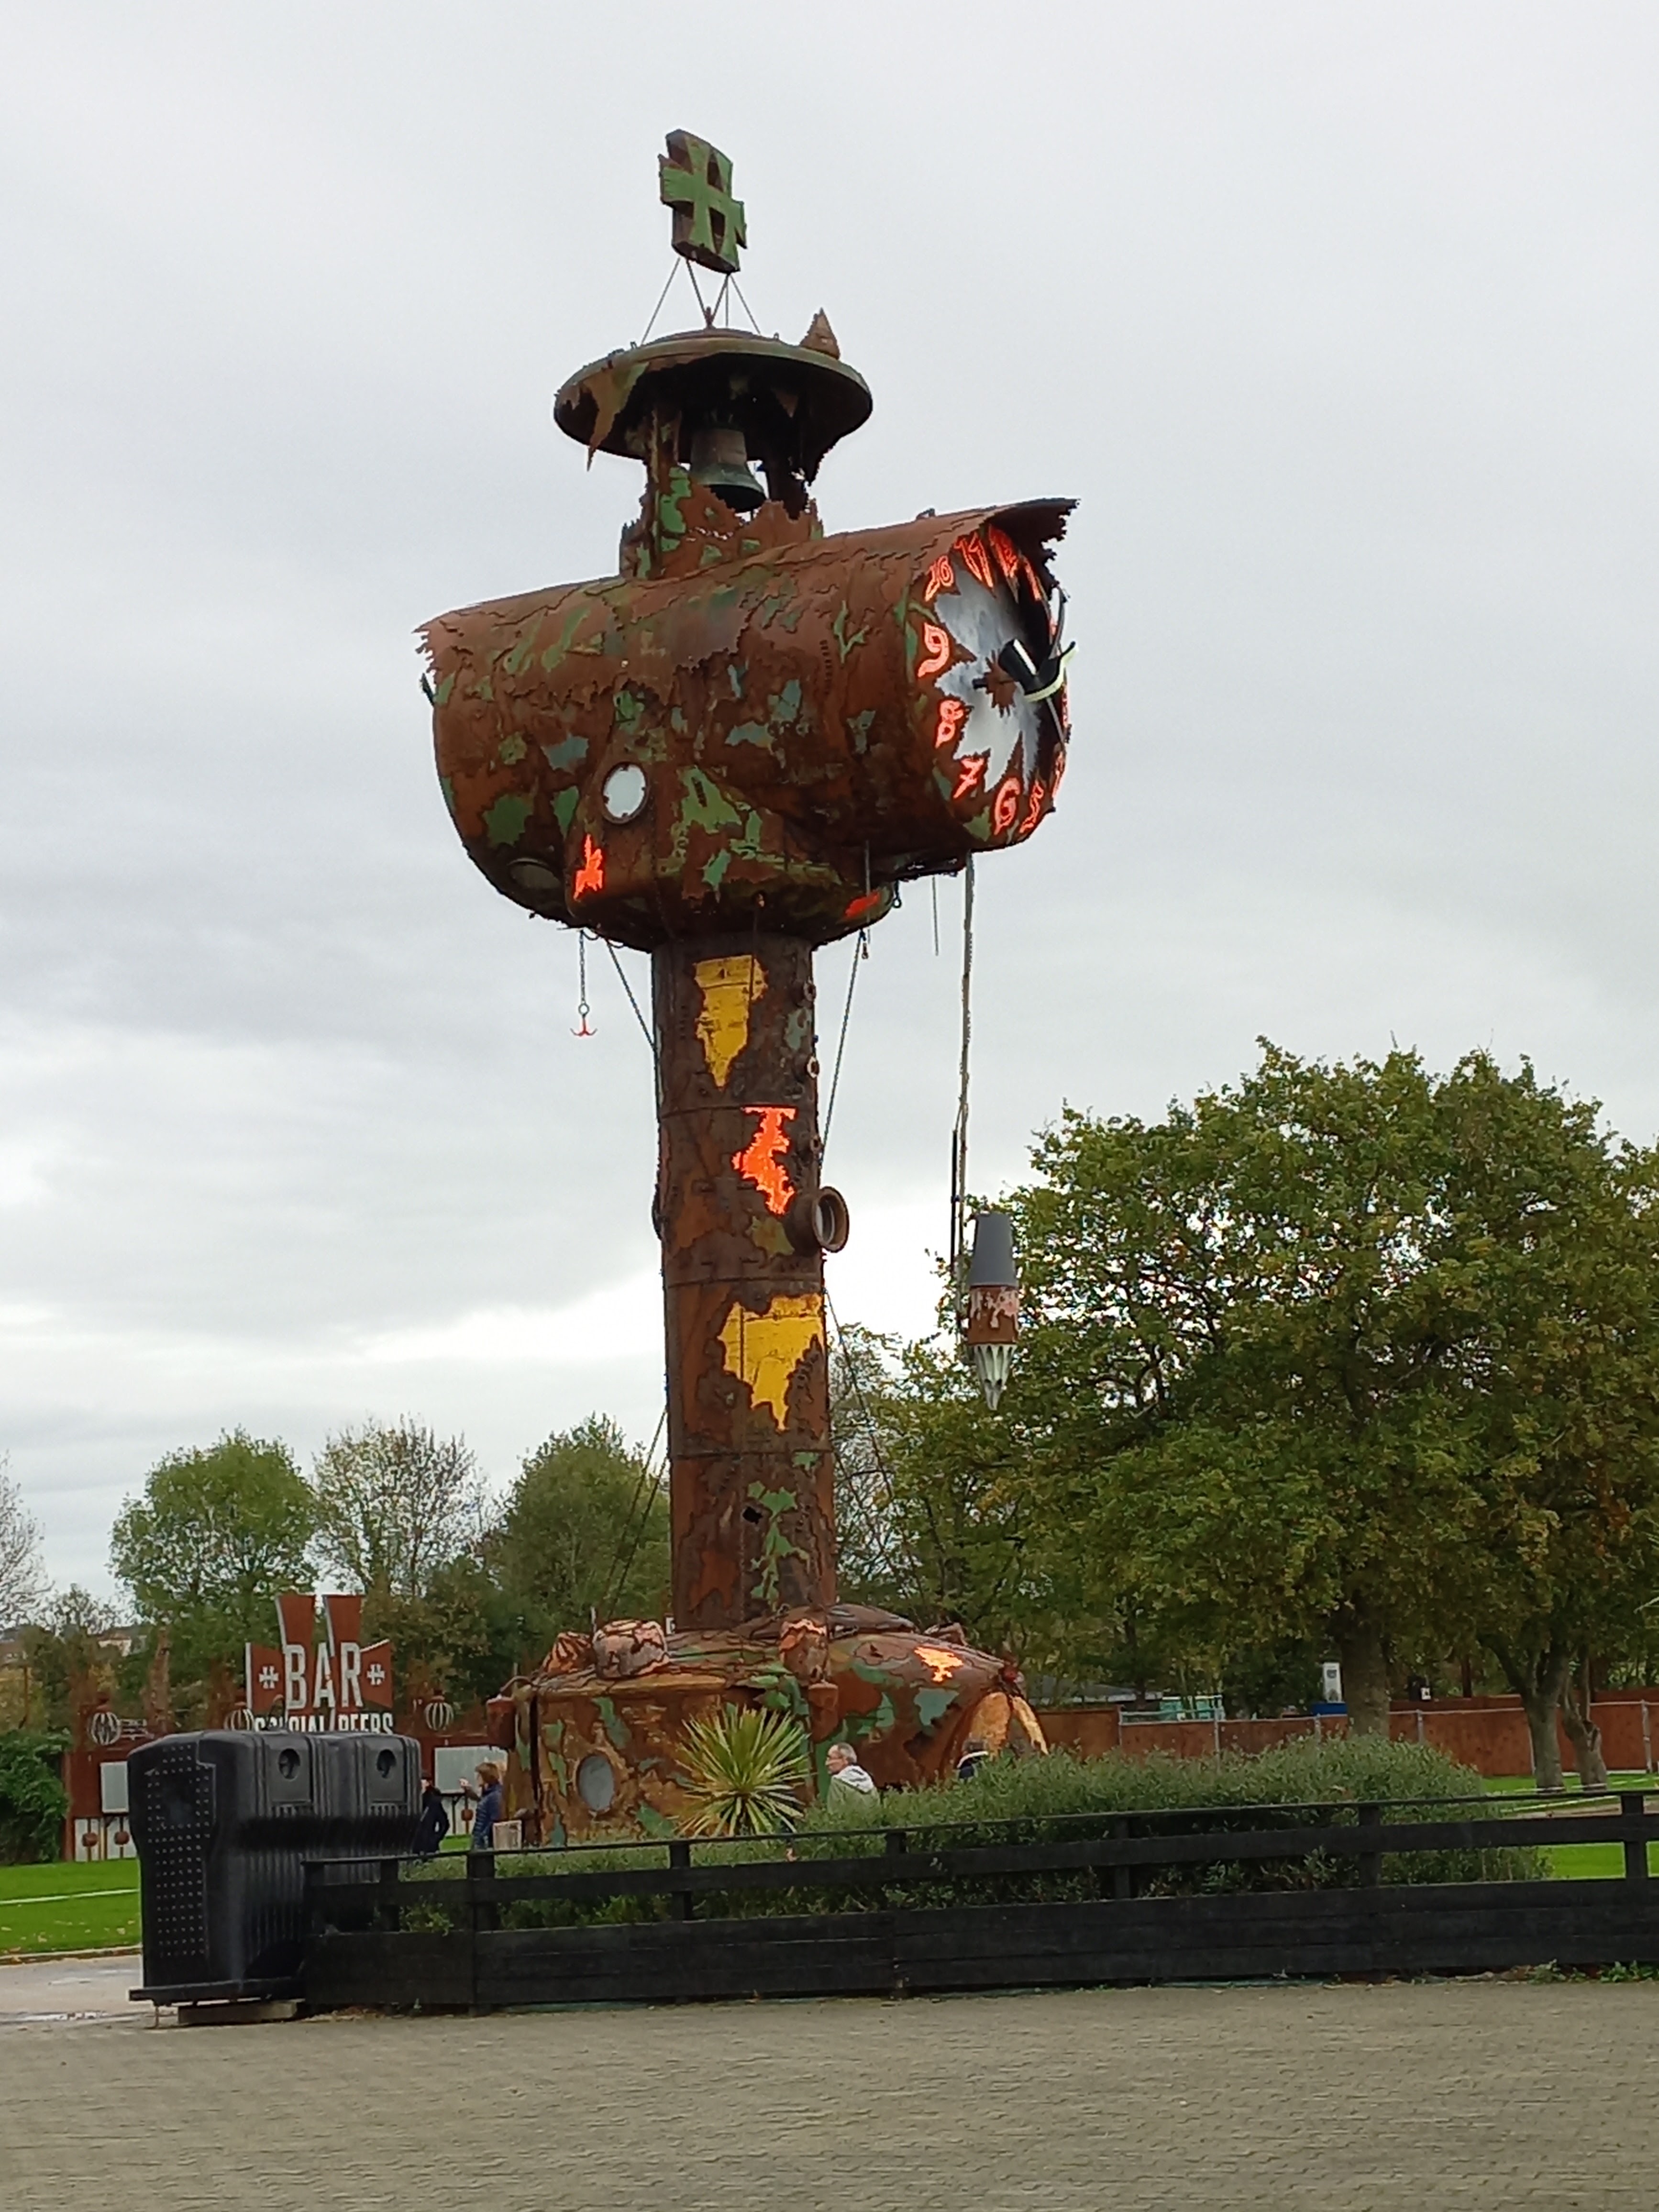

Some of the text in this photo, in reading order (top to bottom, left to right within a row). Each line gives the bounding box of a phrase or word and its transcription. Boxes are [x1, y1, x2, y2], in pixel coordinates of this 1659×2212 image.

[924, 555, 954, 602] 10
[917, 622, 950, 677] 9
[935, 699, 964, 749] 8
[953, 757, 984, 799] 7
[994, 776, 1021, 836] 6
[285, 1642, 364, 1710] BAR
[338, 1712, 394, 1735] BEERS
